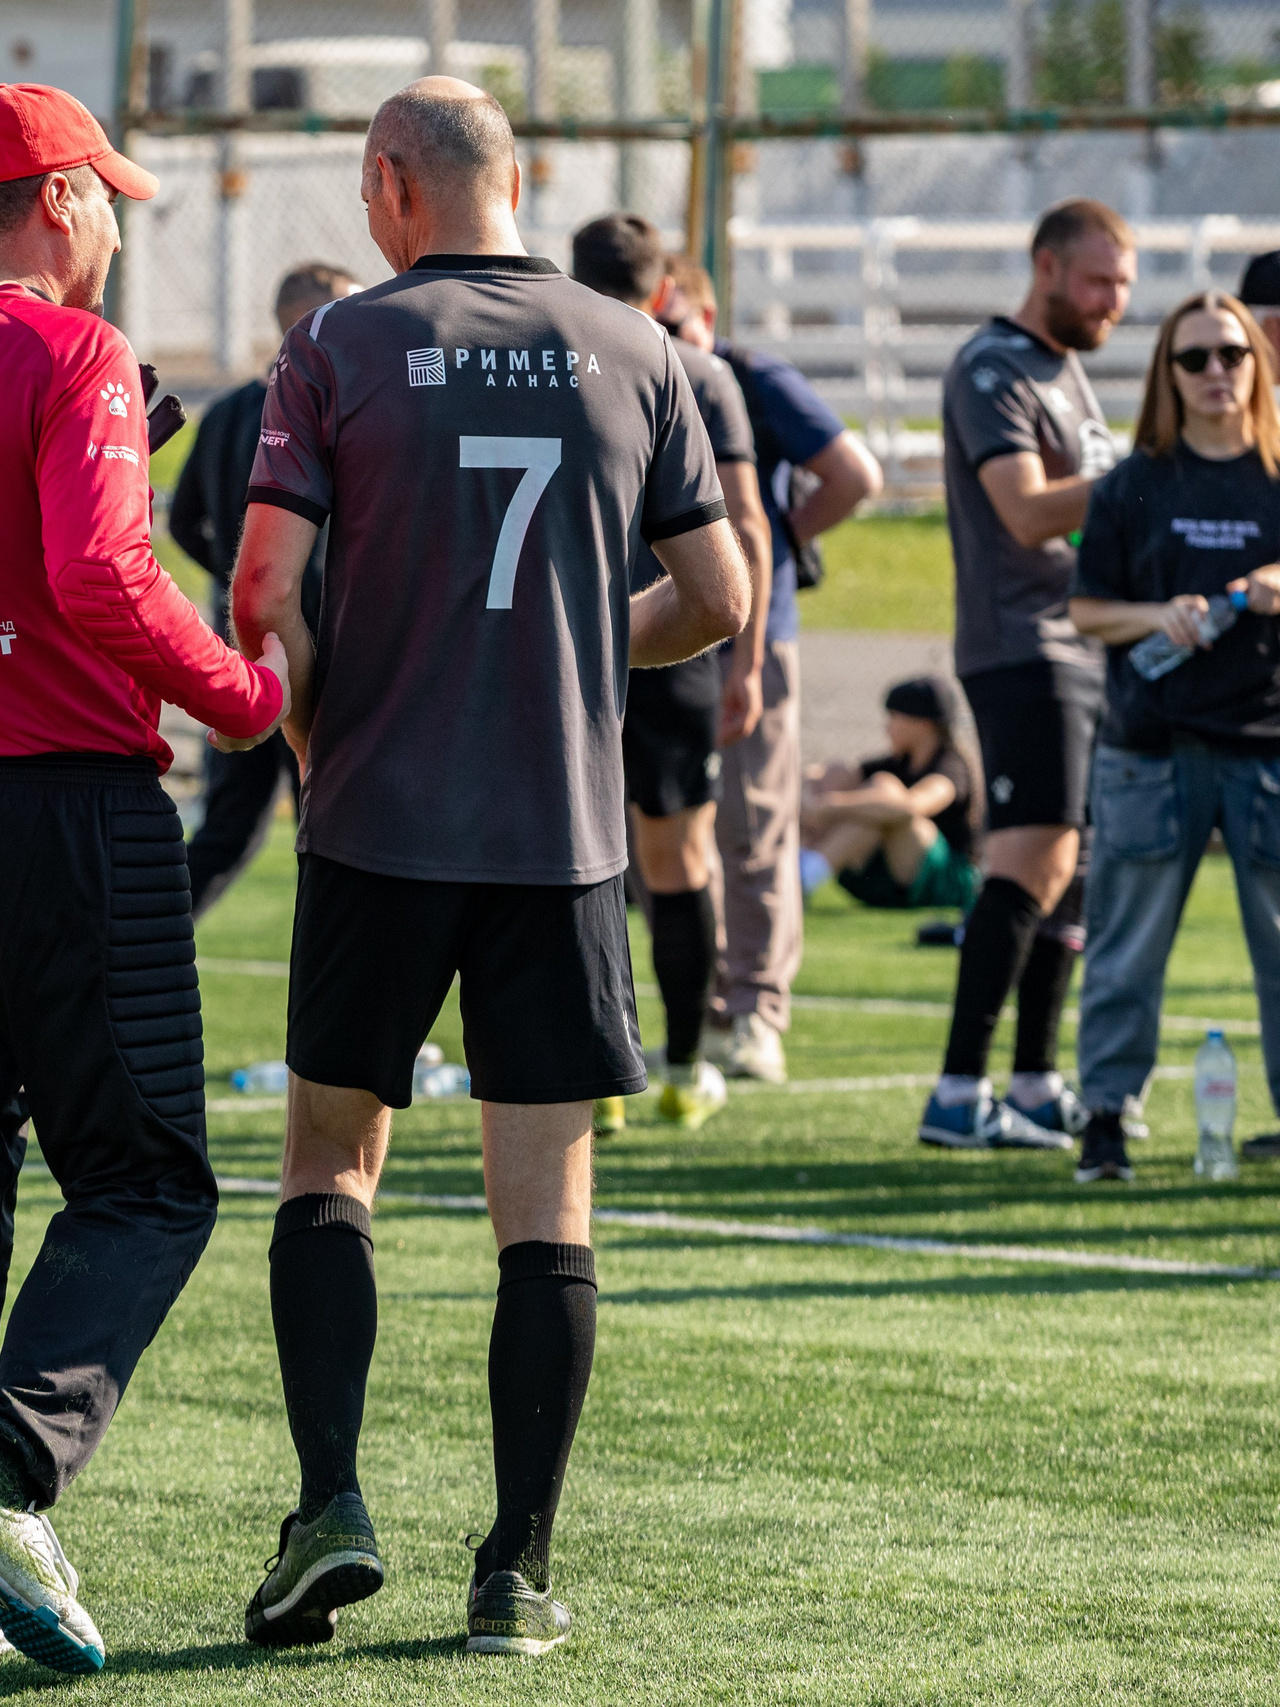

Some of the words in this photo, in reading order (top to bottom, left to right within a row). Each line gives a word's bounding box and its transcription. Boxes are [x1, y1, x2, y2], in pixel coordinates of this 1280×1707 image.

[455, 348, 602, 375] РИМЕРА
[486, 373, 579, 388] АЛНАС
[459, 435, 562, 610] 7
